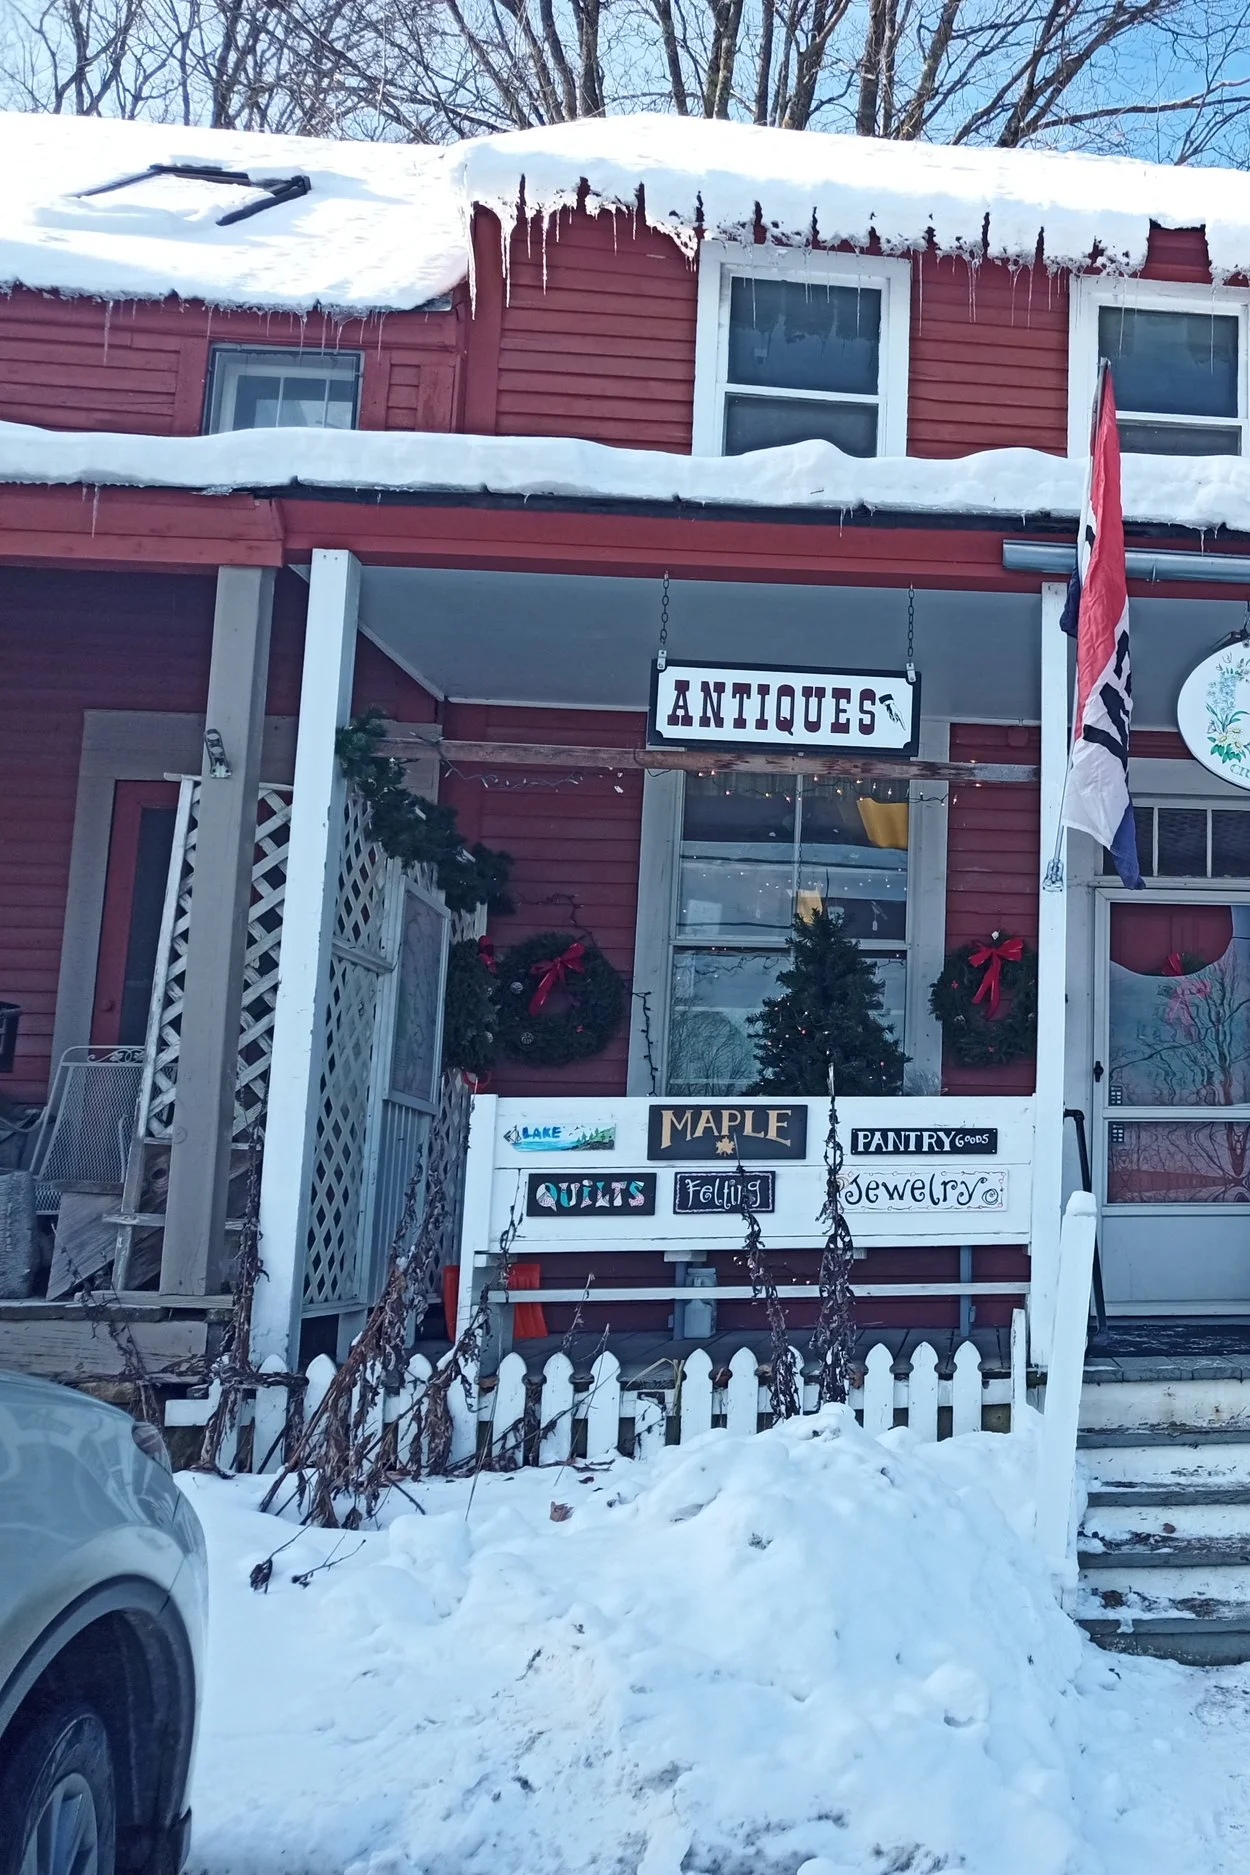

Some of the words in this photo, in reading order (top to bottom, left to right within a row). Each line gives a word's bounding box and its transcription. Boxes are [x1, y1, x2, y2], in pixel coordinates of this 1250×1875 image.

[667, 679, 876, 736] ANTIQUES
[522, 1126, 562, 1140] LAKE
[660, 1109, 792, 1149] MAPLE
[857, 1131, 956, 1152] PANTRY
[845, 1173, 988, 1206] Jewelry
